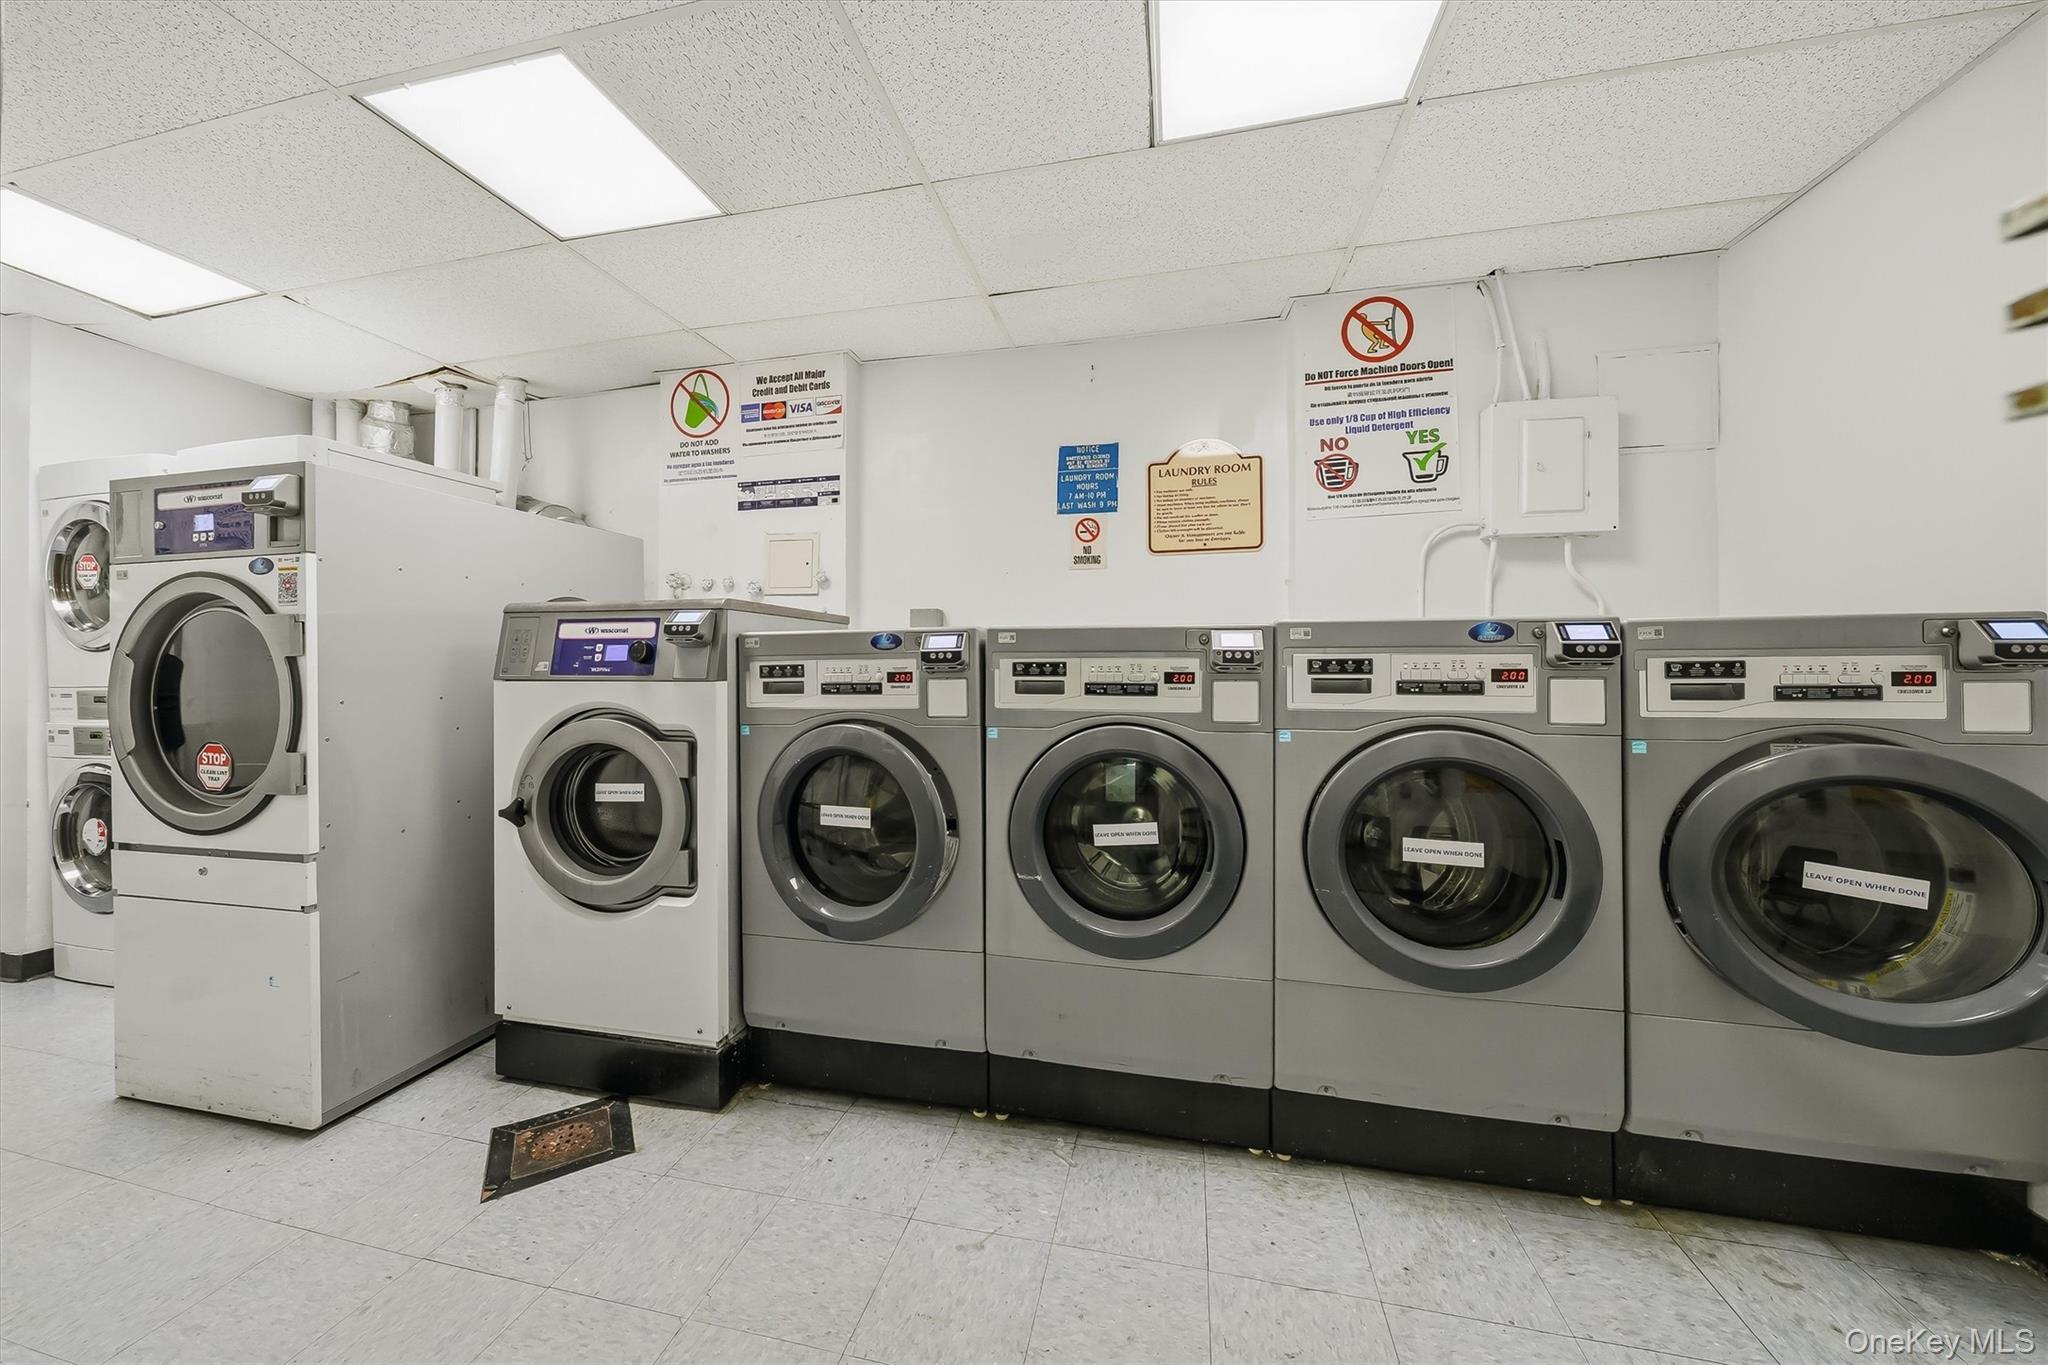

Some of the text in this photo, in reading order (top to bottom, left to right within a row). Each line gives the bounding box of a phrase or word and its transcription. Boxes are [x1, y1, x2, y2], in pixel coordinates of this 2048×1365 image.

[1304, 358, 1454, 381] Do NOT Force Machine Doors Open!
[756, 369, 826, 385] We Accept All Major
[752, 380, 831, 397] Credit and Debit Cards
[789, 402, 813, 414] VISA
[1309, 405, 1451, 427] Use only 1/8 Cup of High Efficiency
[1344, 420, 1414, 435] Liquid Detergent
[1405, 428, 1441, 444] YES
[1076, 445, 1100, 453] NOTICE
[1319, 437, 1349, 452] NO
[669, 450, 691, 458] WATER
[700, 447, 731, 456] WASHERS
[1158, 463, 1252, 478] LAUNDRY ROOM
[1060, 474, 1092, 482] LAUNDRY
[1191, 477, 1218, 487] RULES
[1076, 482, 1099, 490] HOURS
[1057, 502, 1074, 510] LAST
[1076, 501, 1097, 509] WASH
[1106, 500, 1118, 508] PM
[1082, 545, 1092, 555] NO
[79, 561, 96, 570] STOP
[1073, 555, 1102, 565] SMOKING
[1903, 674, 1933, 684] 2.00
[201, 752, 227, 765] STOP
[1404, 846, 1424, 854] LEAVE
[1442, 849, 1463, 857] WHEN
[1805, 872, 1927, 898] LEAVE OPEN WHEN DONE
